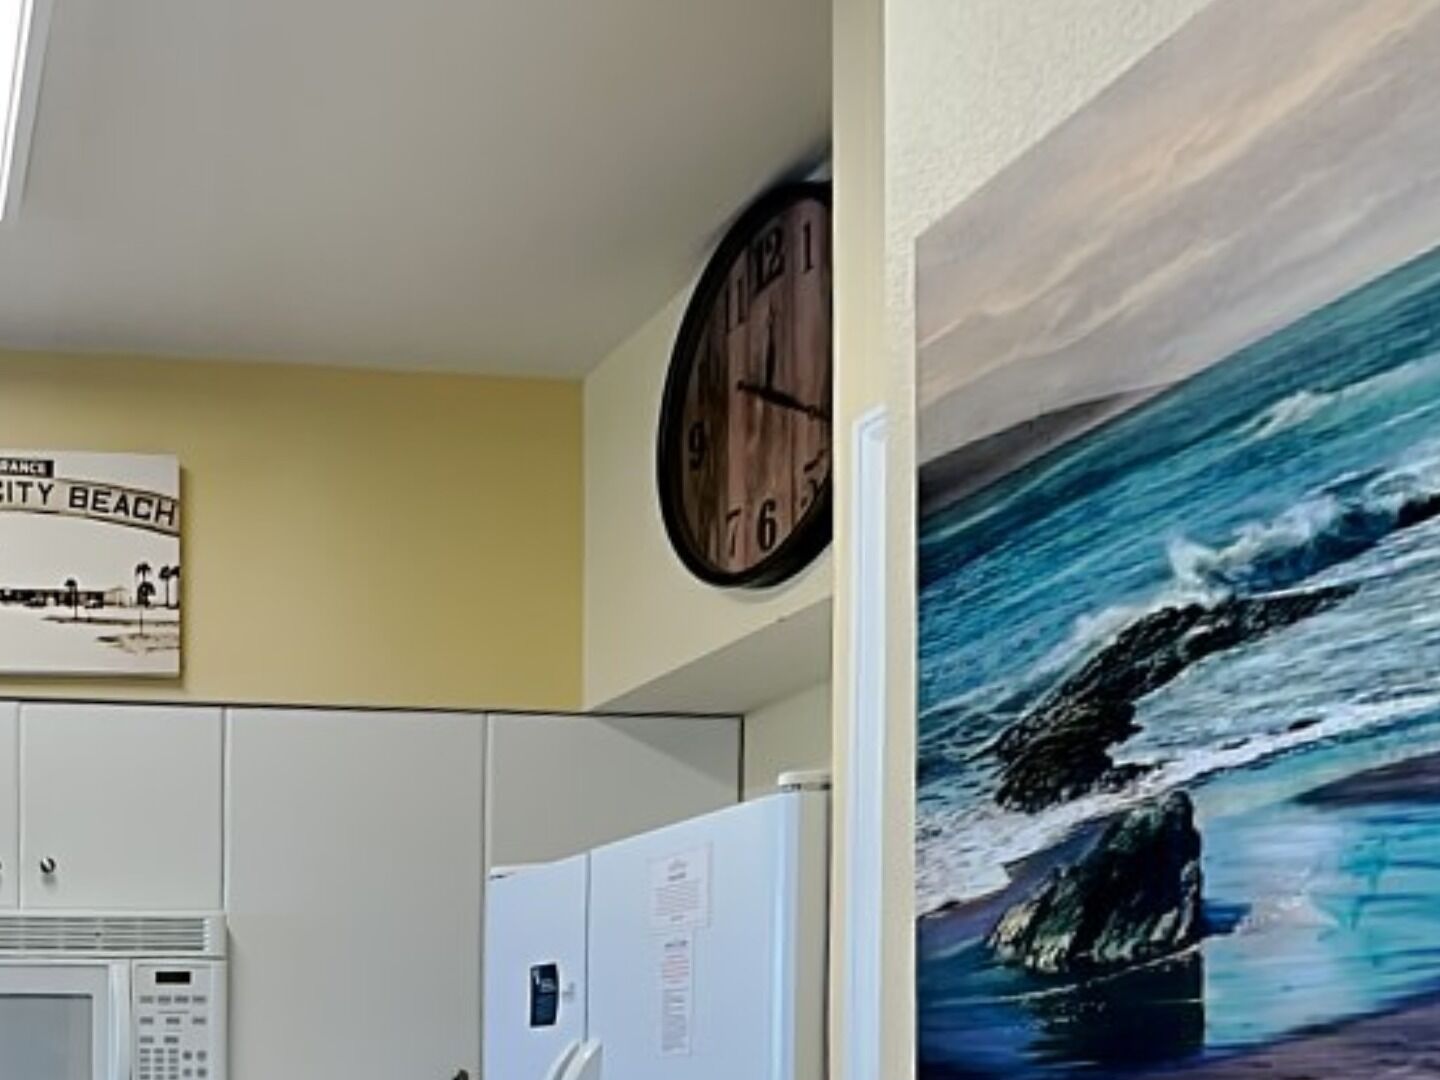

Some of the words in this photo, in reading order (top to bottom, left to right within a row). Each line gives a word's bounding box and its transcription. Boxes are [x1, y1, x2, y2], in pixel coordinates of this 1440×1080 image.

[757, 225, 786, 290] 12
[725, 275, 747, 334] 11
[688, 422, 708, 471] 9
[68, 486, 176, 526] BEACH
[757, 499, 776, 551] 6
[726, 507, 742, 557] 7
